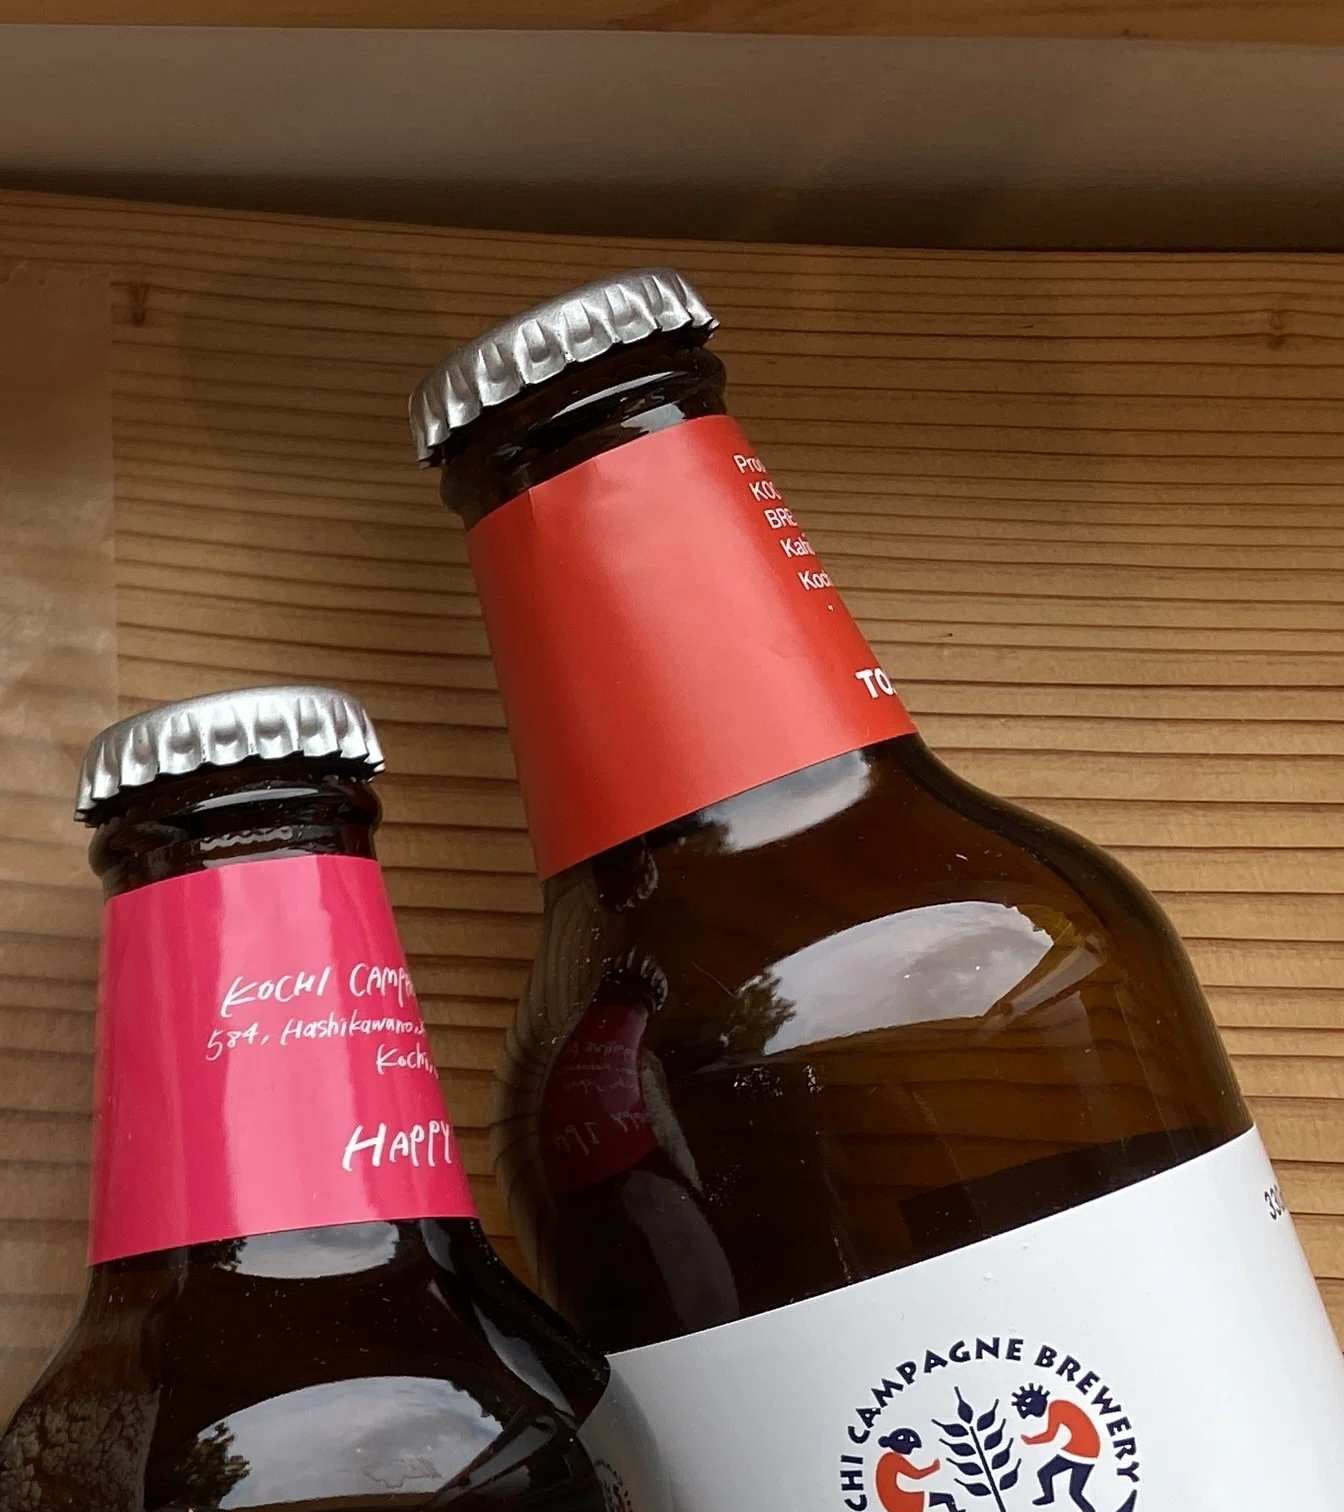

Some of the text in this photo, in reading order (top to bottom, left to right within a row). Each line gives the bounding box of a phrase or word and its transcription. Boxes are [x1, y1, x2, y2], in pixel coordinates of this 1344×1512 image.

[733, 454, 767, 474] Pro
[855, 667, 897, 699] TO
[220, 966, 331, 1018] KOCHI
[342, 1120, 452, 1172] HAPPY
[848, 1337, 1024, 1444] CAMPAGNE
[1034, 1344, 1140, 1483] BREWERY
